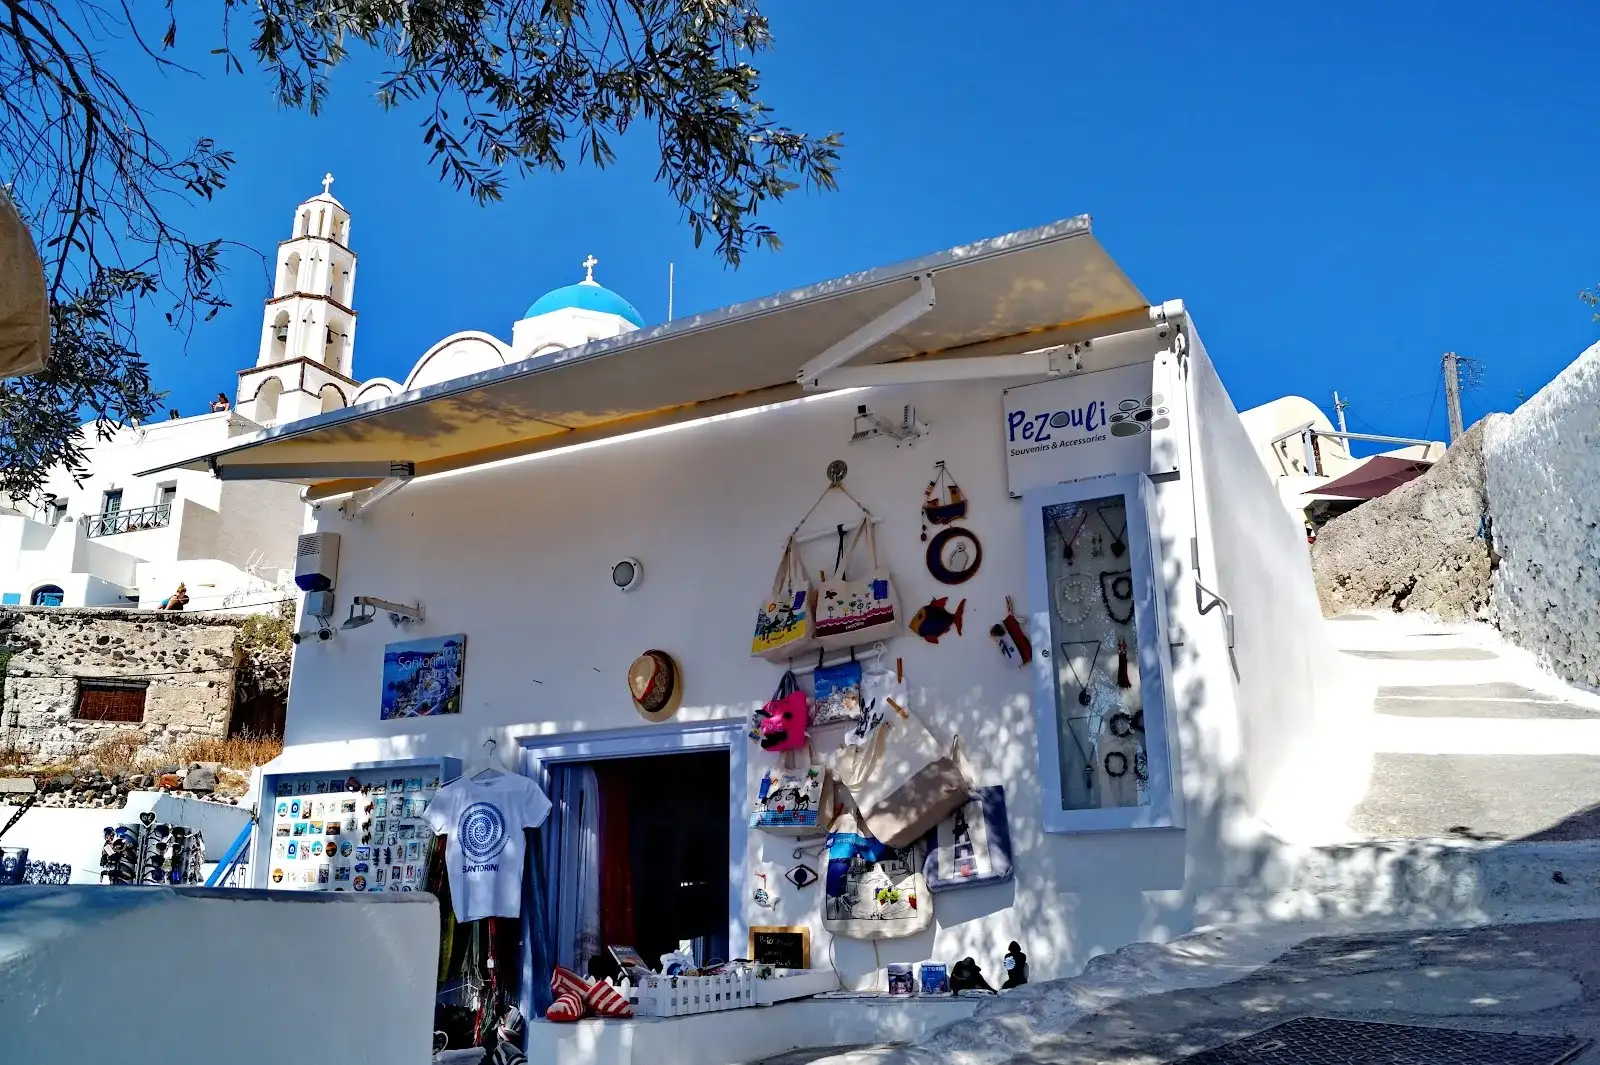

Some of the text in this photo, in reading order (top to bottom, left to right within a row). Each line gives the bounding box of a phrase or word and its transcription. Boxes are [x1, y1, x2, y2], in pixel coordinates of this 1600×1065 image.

[1010, 434, 1107, 457] Souvenirs & Accessories
[462, 864, 499, 873] SANTORINI
